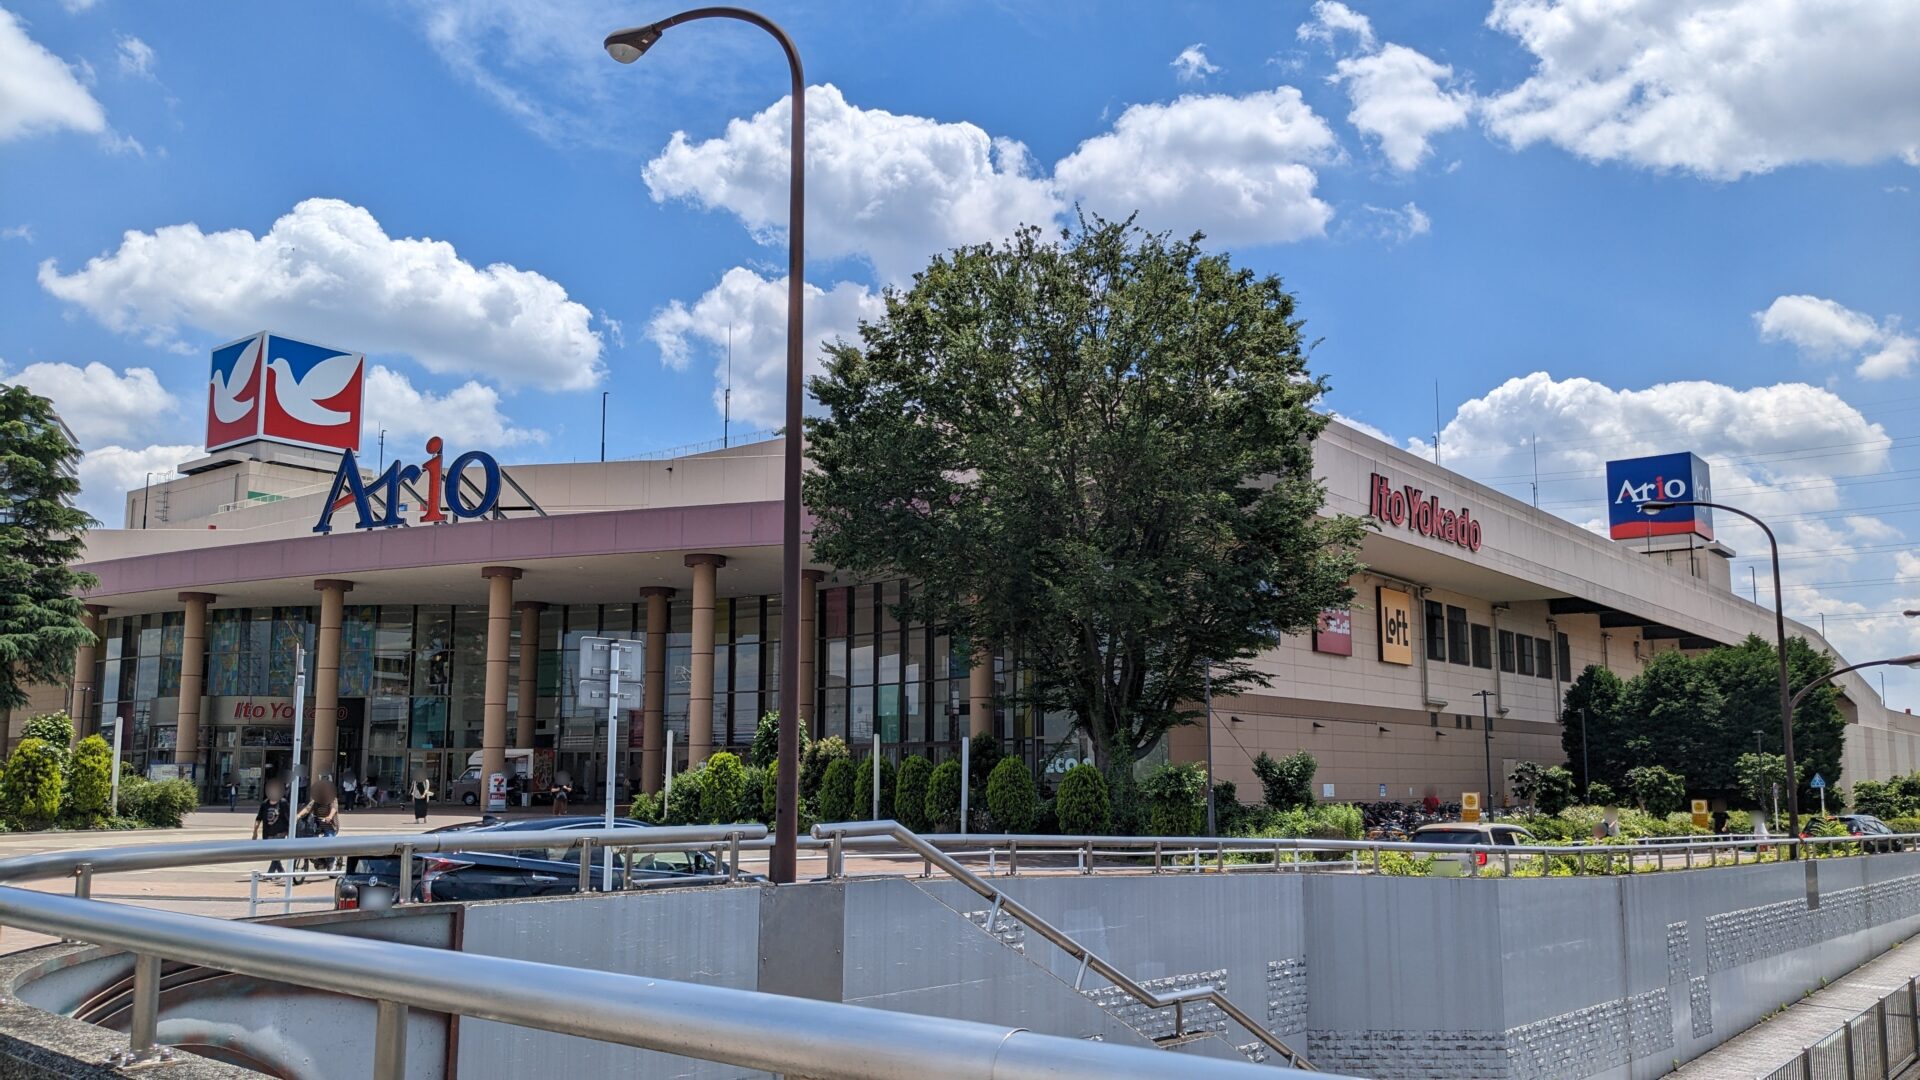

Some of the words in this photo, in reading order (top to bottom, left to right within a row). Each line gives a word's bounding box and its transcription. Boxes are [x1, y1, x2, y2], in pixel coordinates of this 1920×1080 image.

[313, 436, 501, 532] Ario
[1615, 475, 1686, 504] Ario
[1694, 475, 1711, 504] Aro
[1370, 473, 1405, 527] Ito
[1404, 485, 1481, 553] Yokado
[234, 702, 265, 719] Ito
